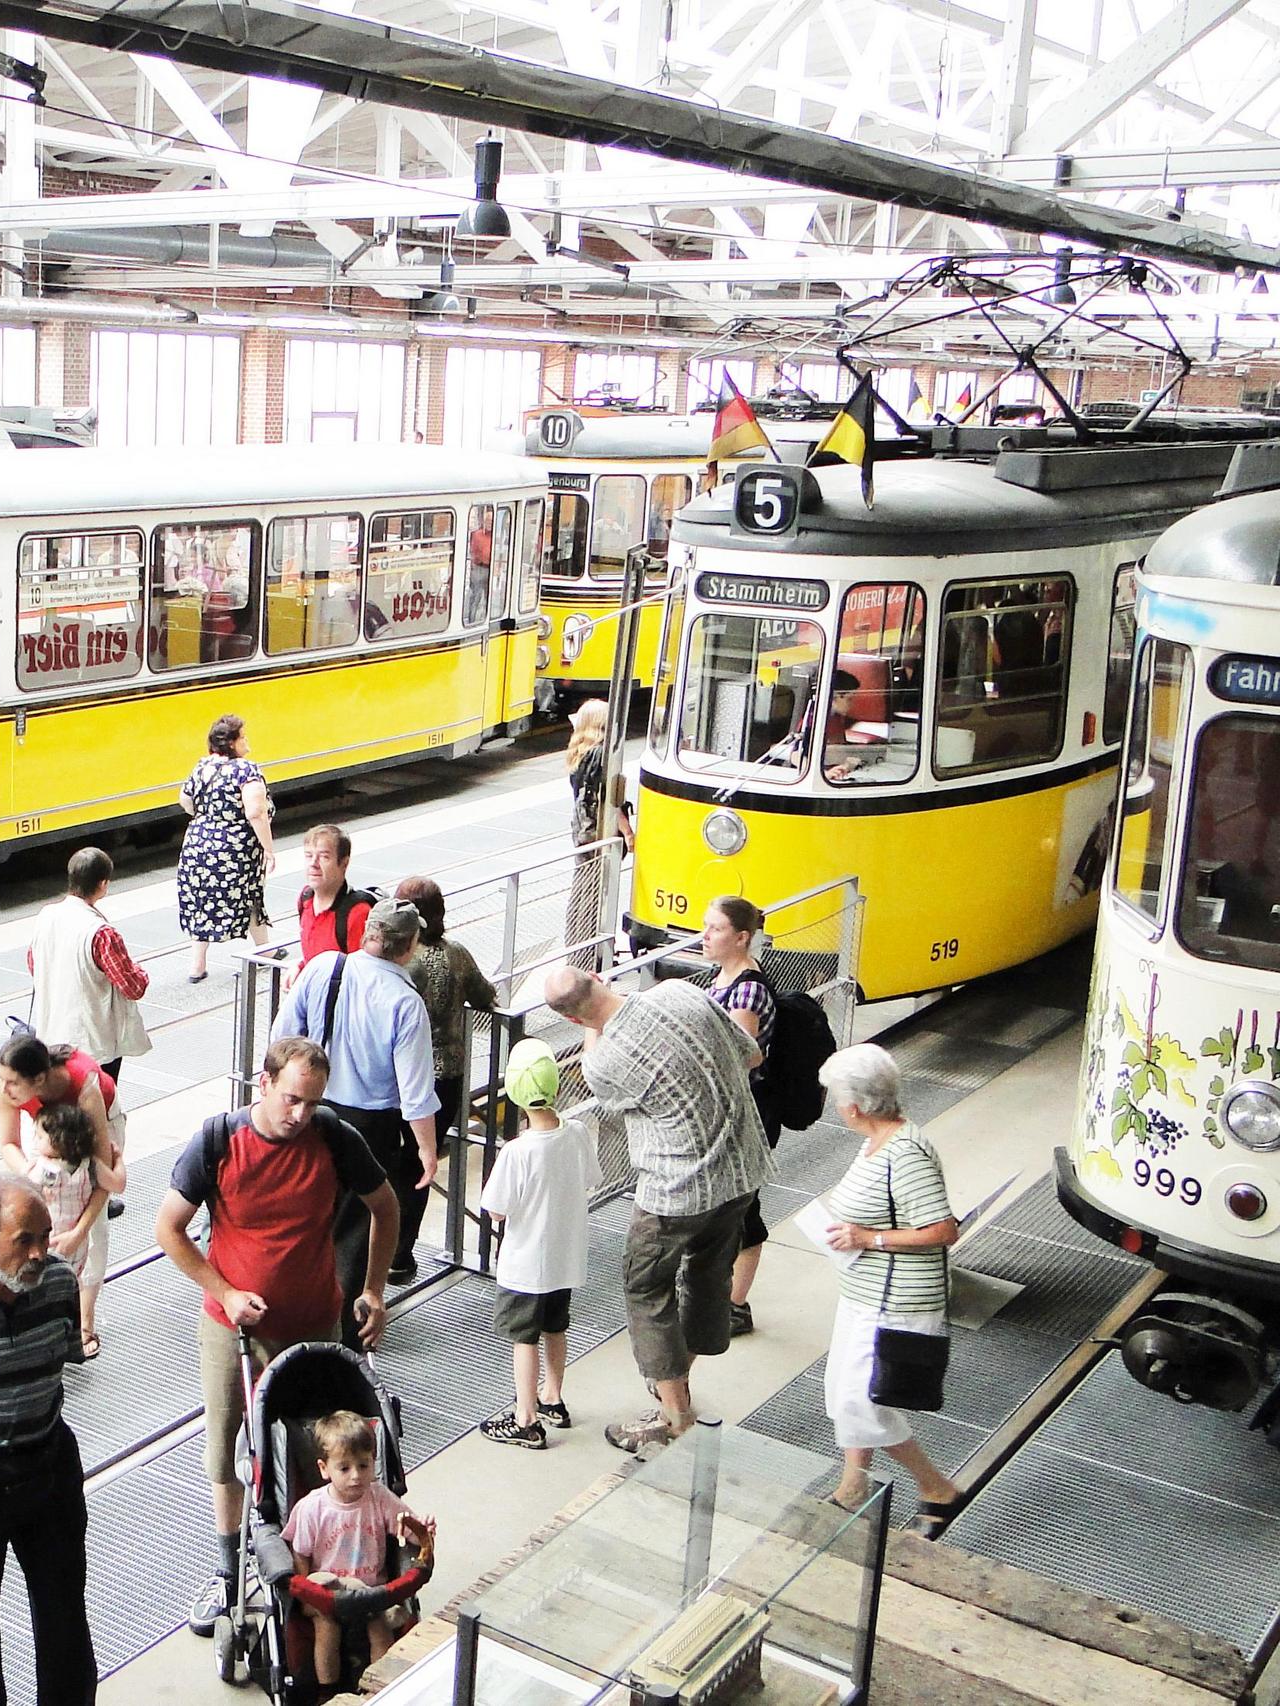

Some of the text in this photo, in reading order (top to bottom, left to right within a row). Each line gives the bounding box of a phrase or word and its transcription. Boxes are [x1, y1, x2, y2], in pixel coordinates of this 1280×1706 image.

[547, 417, 567, 444] 10
[753, 478, 783, 528] 5
[30, 587, 41, 605] 10
[708, 576, 821, 605] Stammheim
[428, 731, 444, 747] 1511
[16, 817, 41, 835] 1511
[654, 888, 688, 915] 519
[930, 938, 960, 962] 519
[1133, 1158, 1203, 1207] 999
